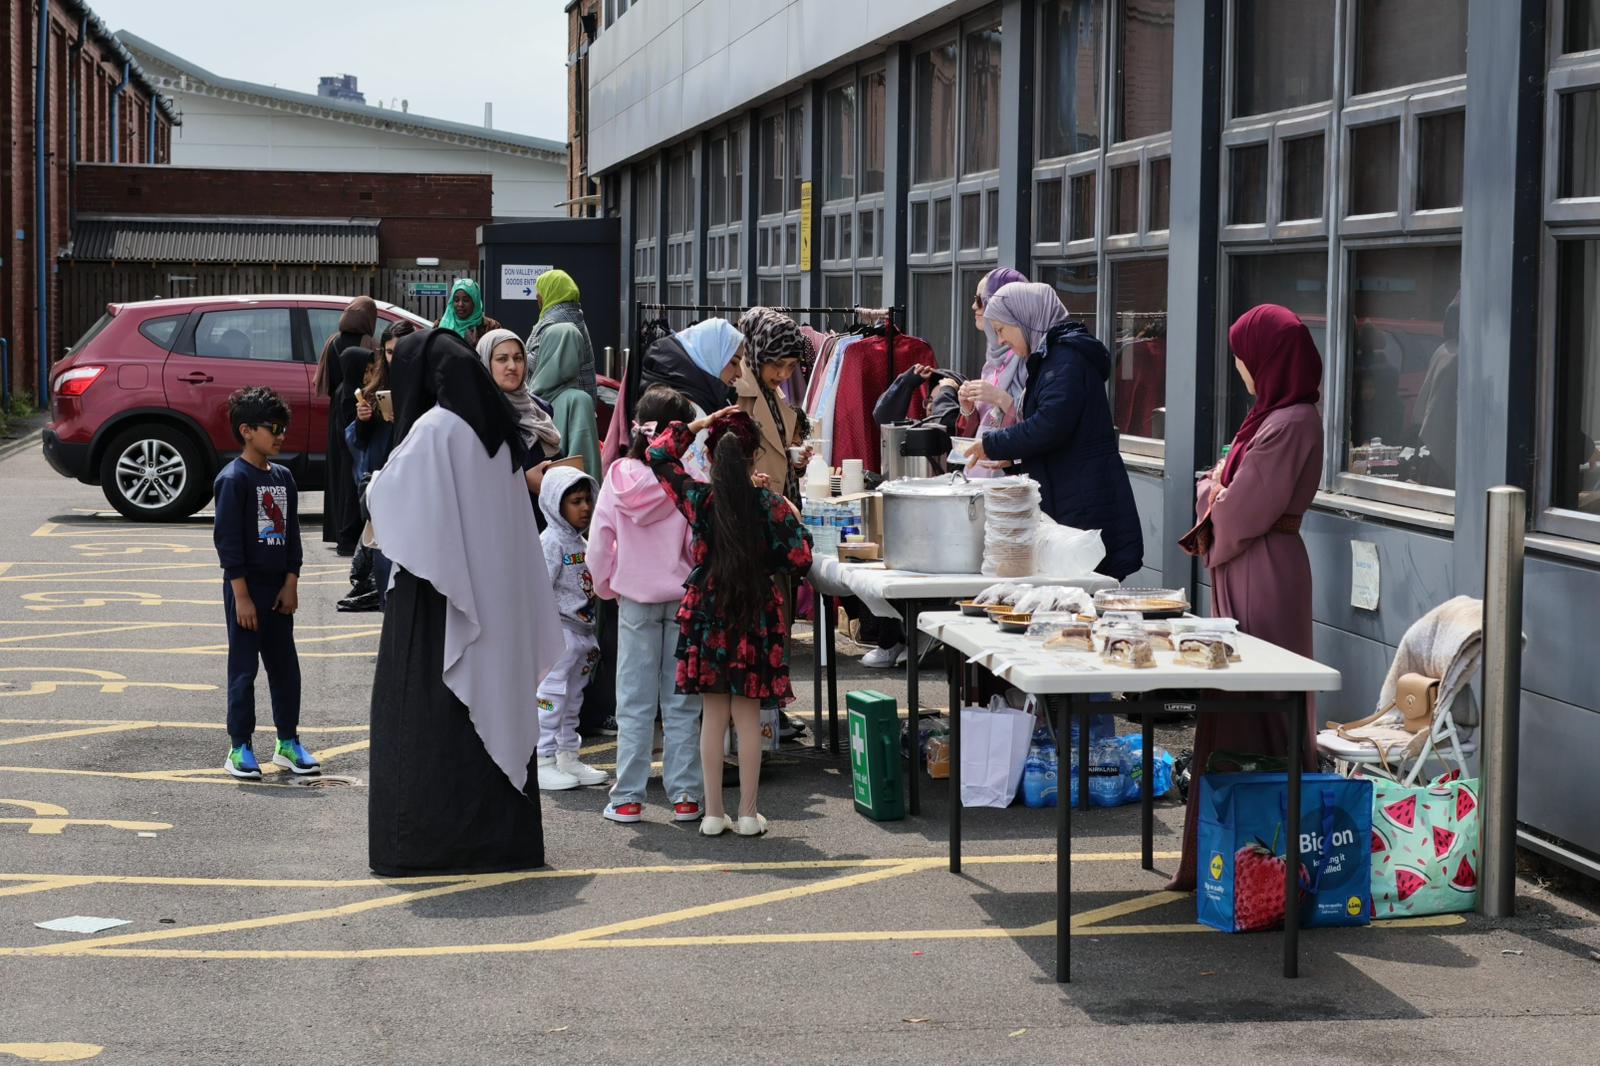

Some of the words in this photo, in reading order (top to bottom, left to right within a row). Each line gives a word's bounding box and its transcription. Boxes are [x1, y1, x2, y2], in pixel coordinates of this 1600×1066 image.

[256, 485, 287, 495] SPIDER
[1332, 829, 1354, 847] on
[1339, 853, 1346, 861] it
